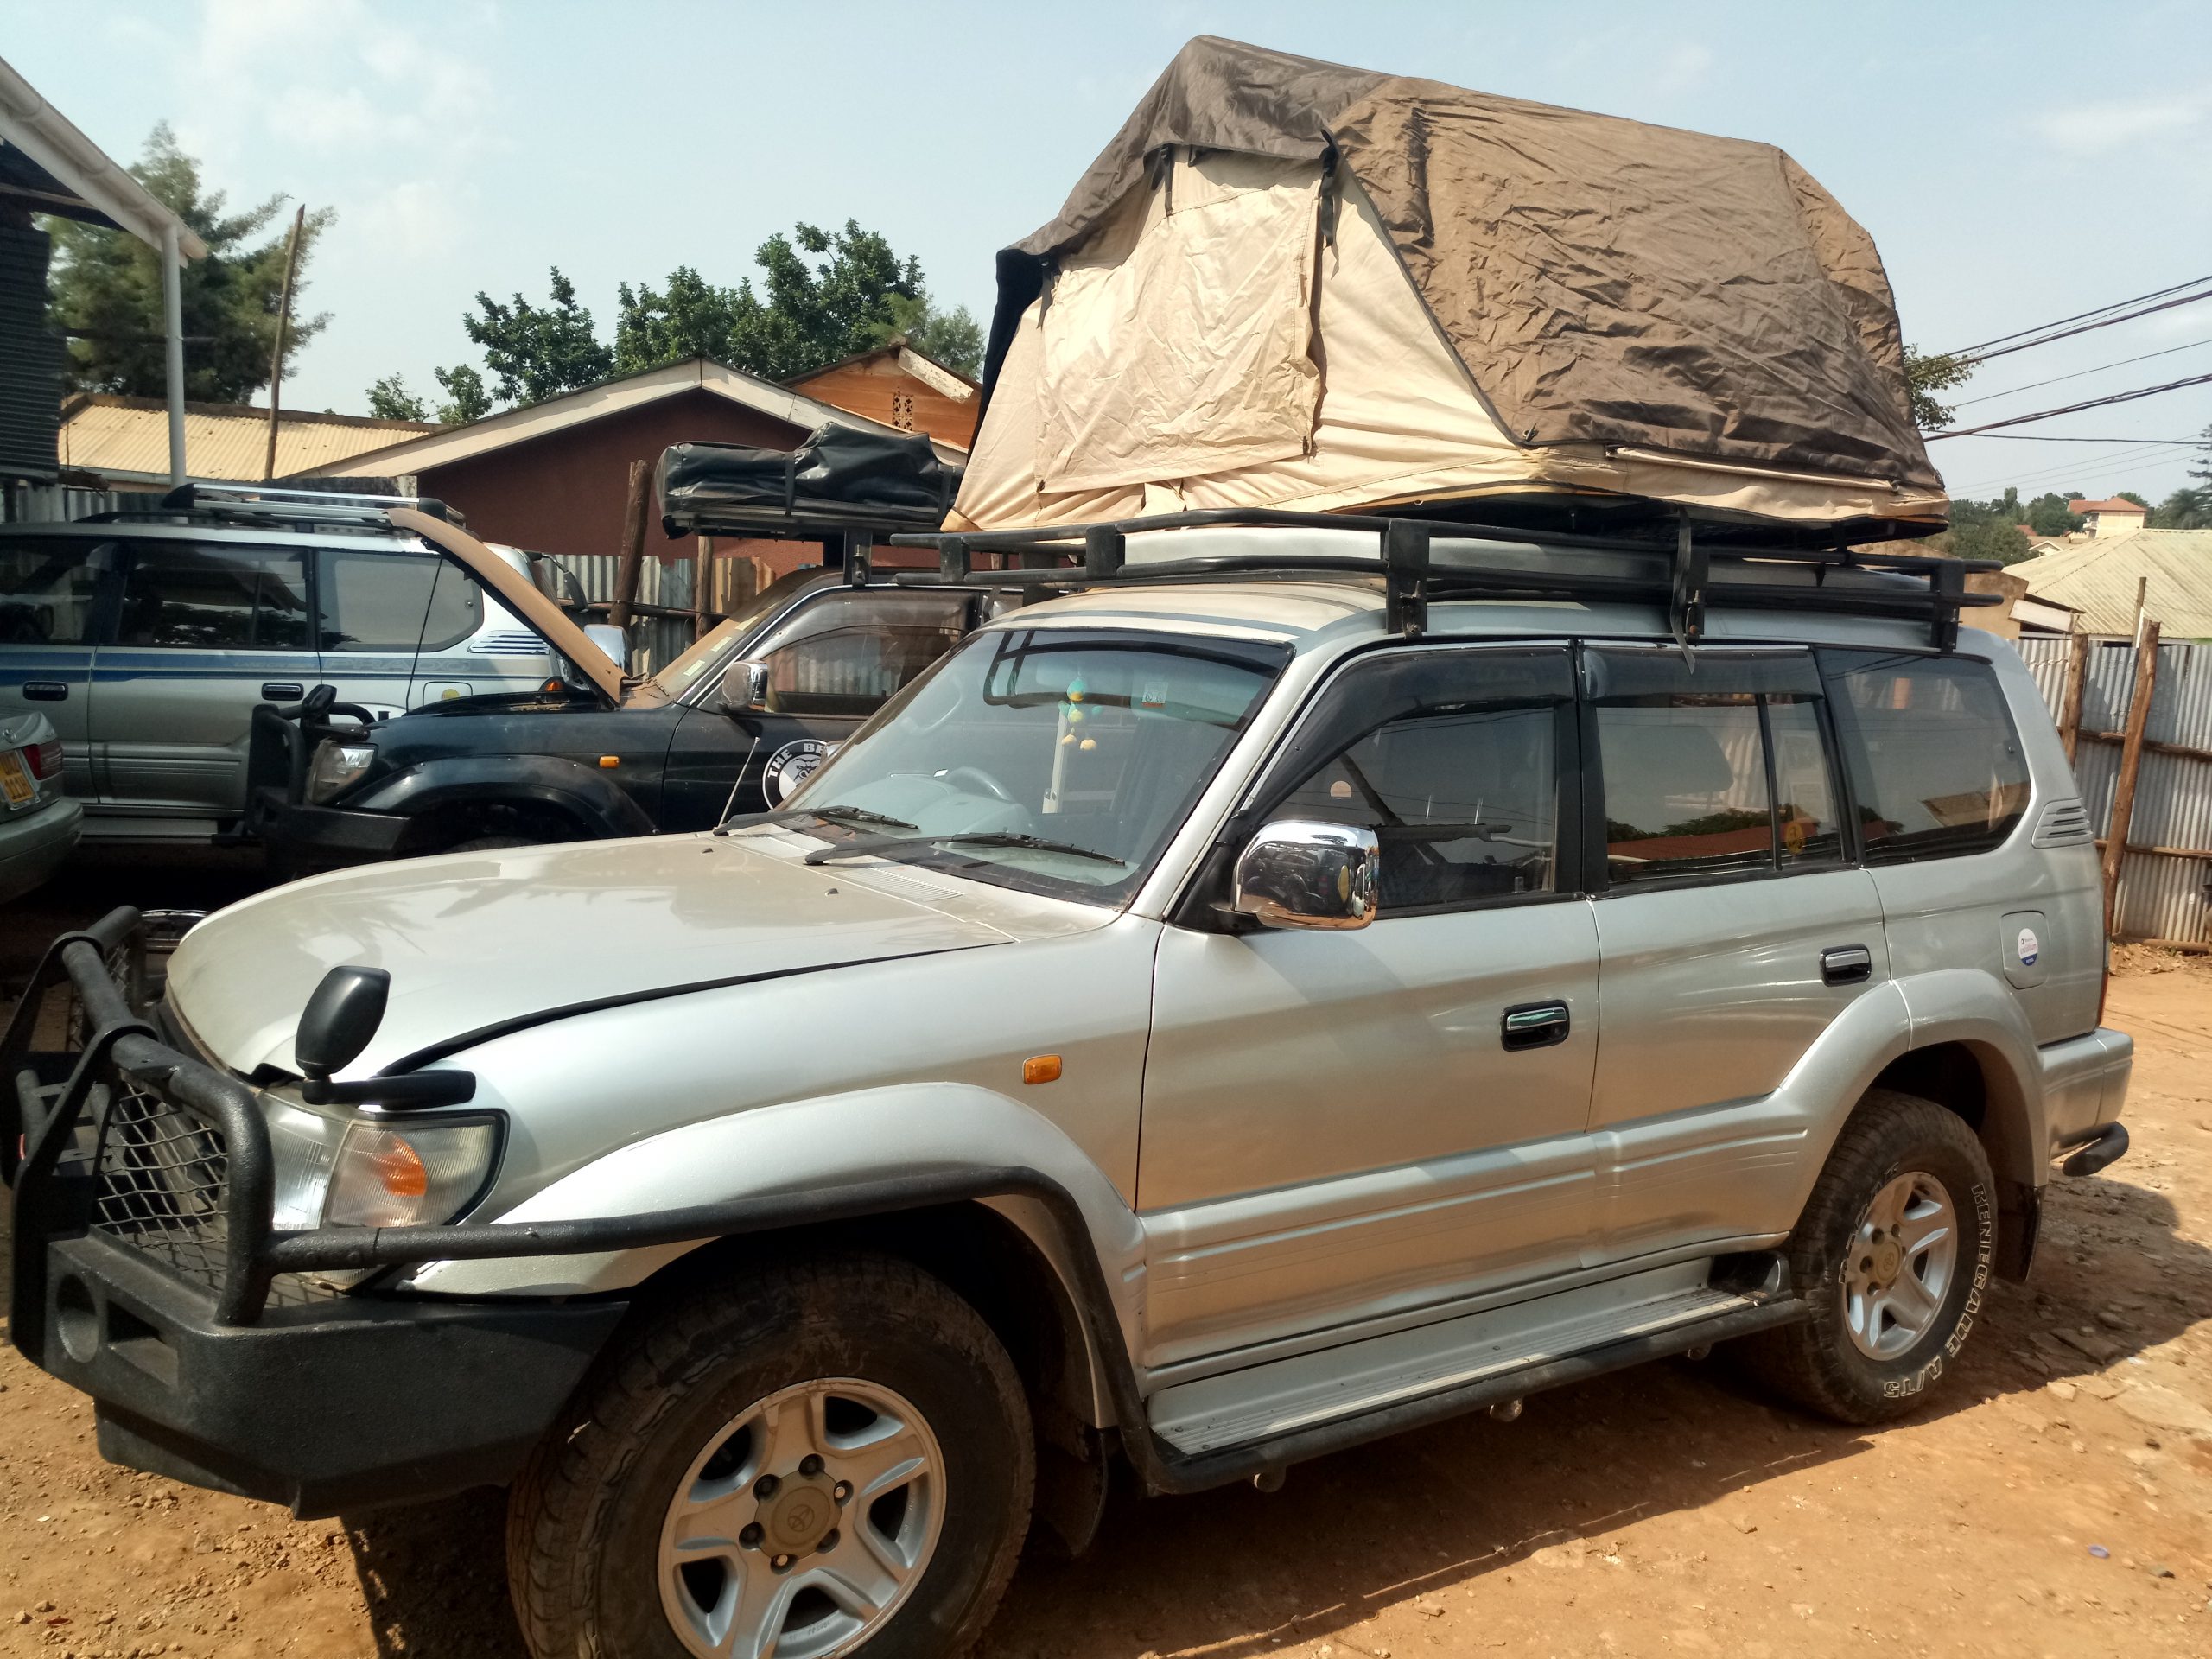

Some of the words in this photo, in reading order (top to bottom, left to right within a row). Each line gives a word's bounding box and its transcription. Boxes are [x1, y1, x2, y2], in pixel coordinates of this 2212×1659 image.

[767, 750, 792, 778] THE
[1945, 1183, 1992, 1358] RENEGADE
[1884, 1355, 1943, 1398] A/T5
